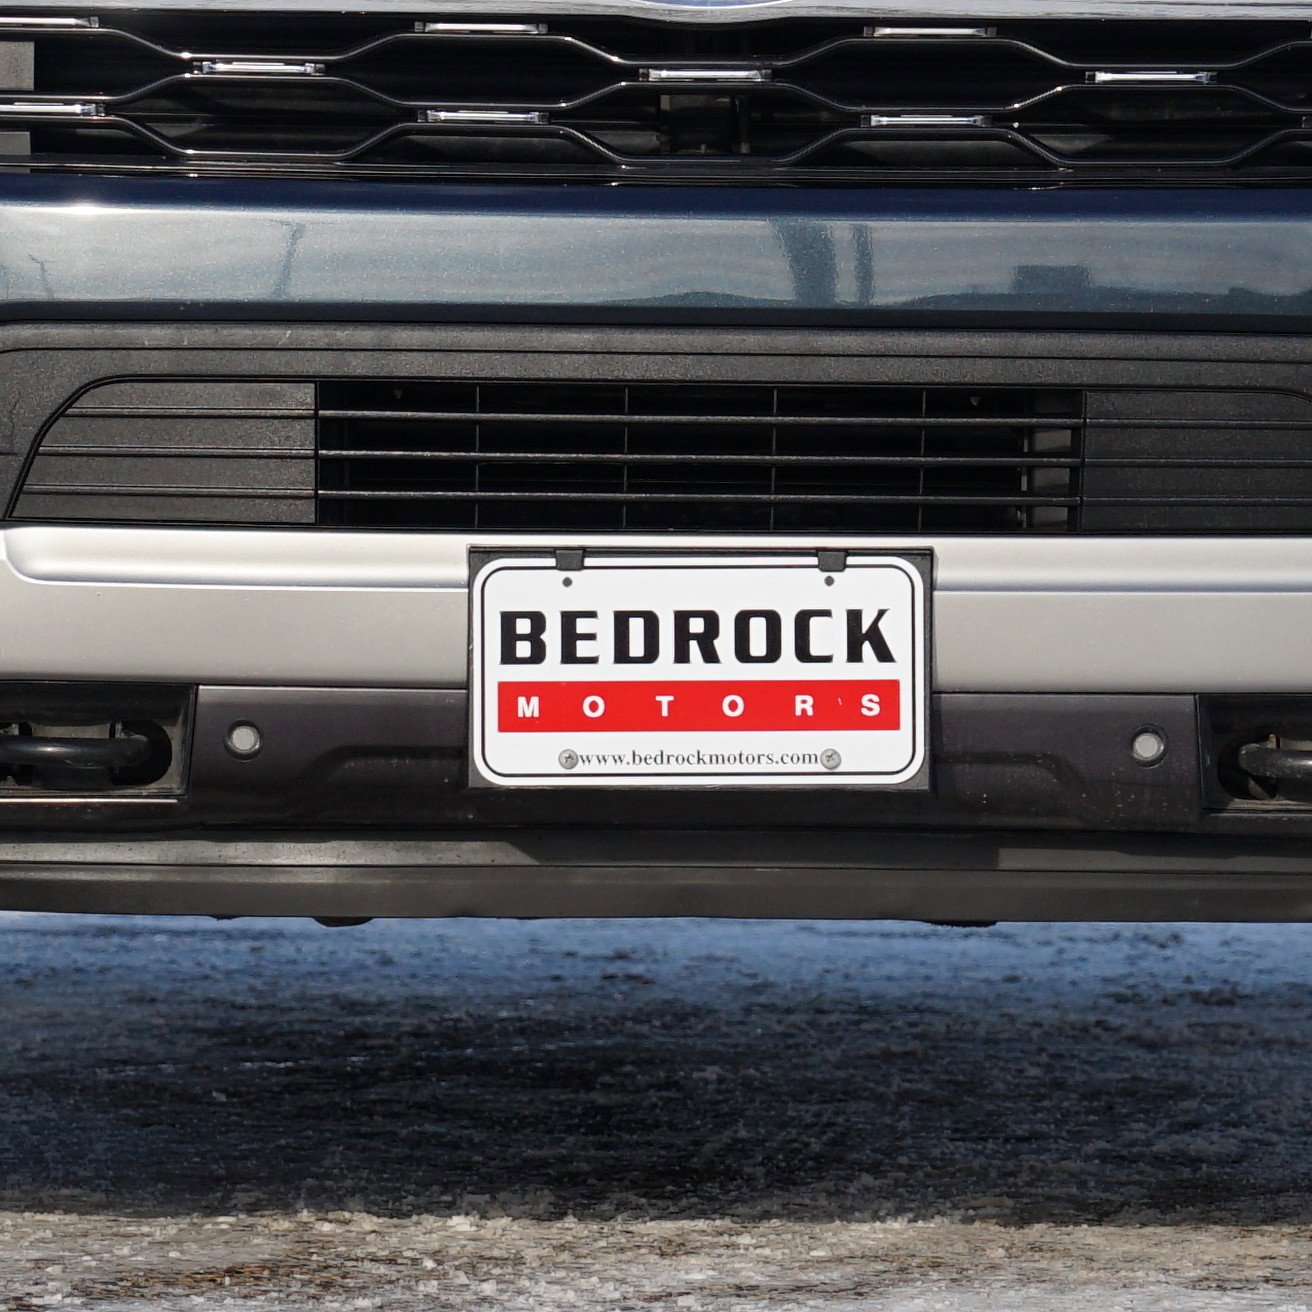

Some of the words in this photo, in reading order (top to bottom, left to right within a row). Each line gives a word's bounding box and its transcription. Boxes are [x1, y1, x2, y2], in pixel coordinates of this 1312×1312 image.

[499, 608, 896, 665] BEDROCK
[516, 694, 881, 718] MOTORS
[580, 749, 819, 766] www.bedrockmotors.com
